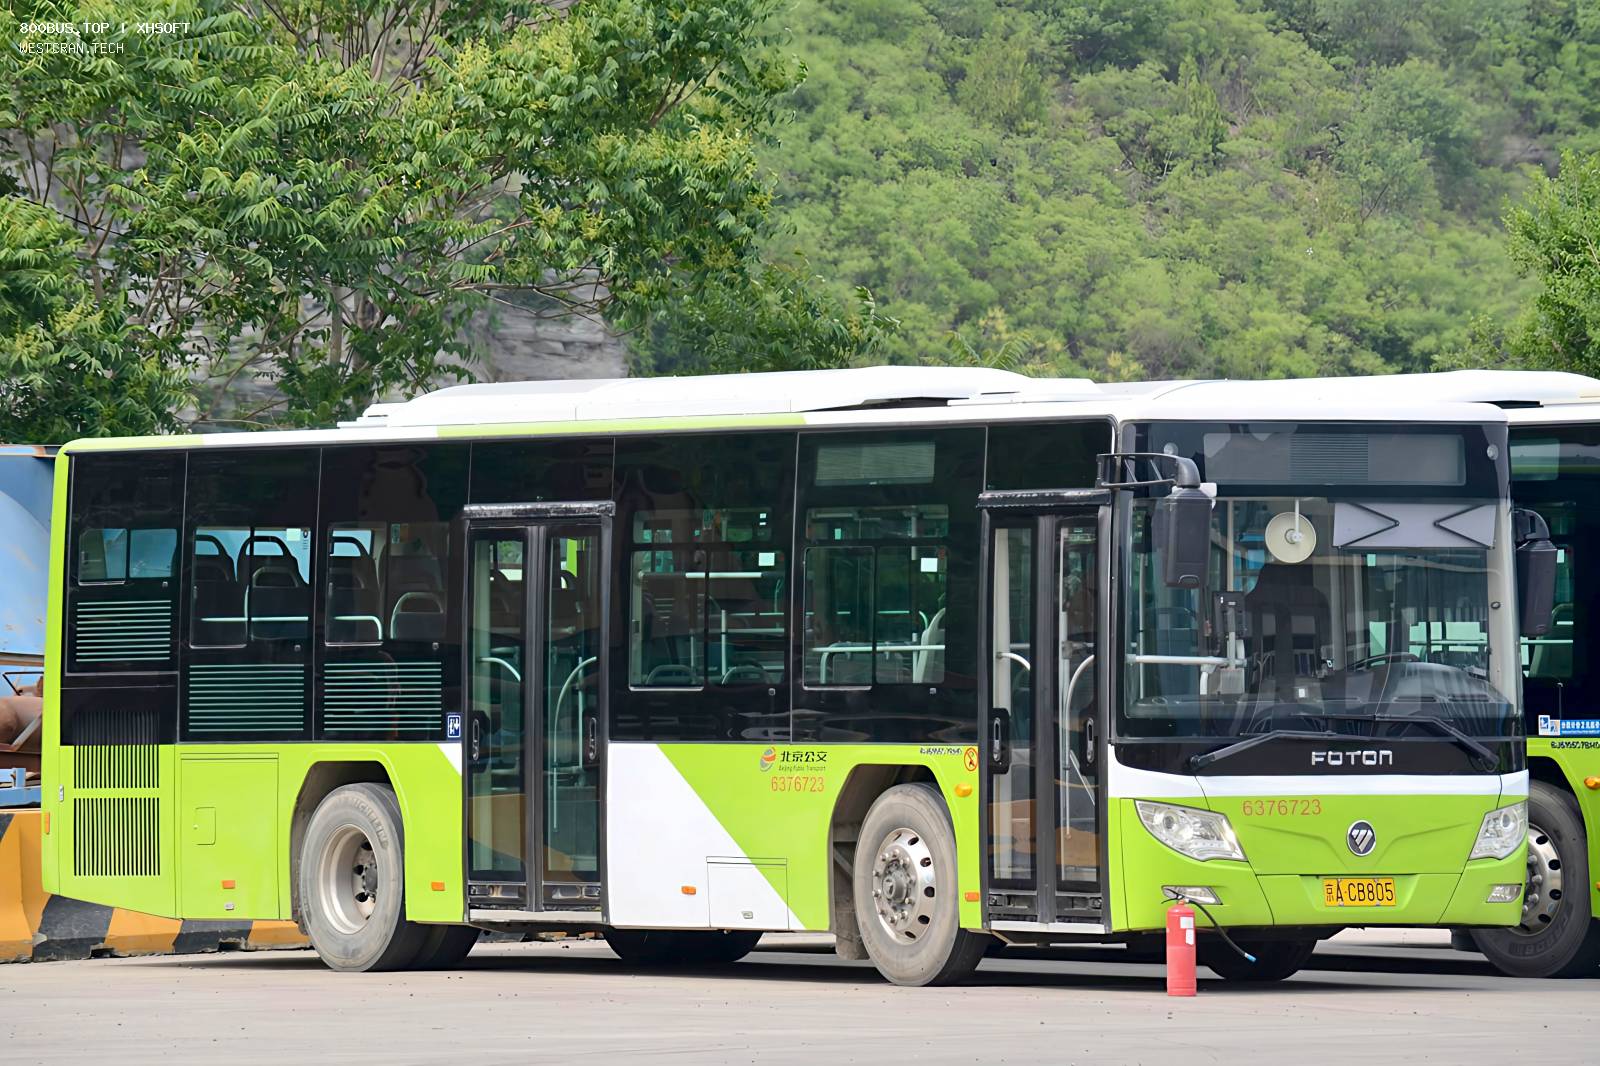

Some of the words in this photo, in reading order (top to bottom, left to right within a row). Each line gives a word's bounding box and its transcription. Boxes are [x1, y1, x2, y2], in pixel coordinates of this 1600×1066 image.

[781, 751, 827, 762] 北京公交
[1311, 750, 1393, 765] FOTON
[771, 776, 824, 792] 6376723
[1242, 799, 1322, 816] 6376723
